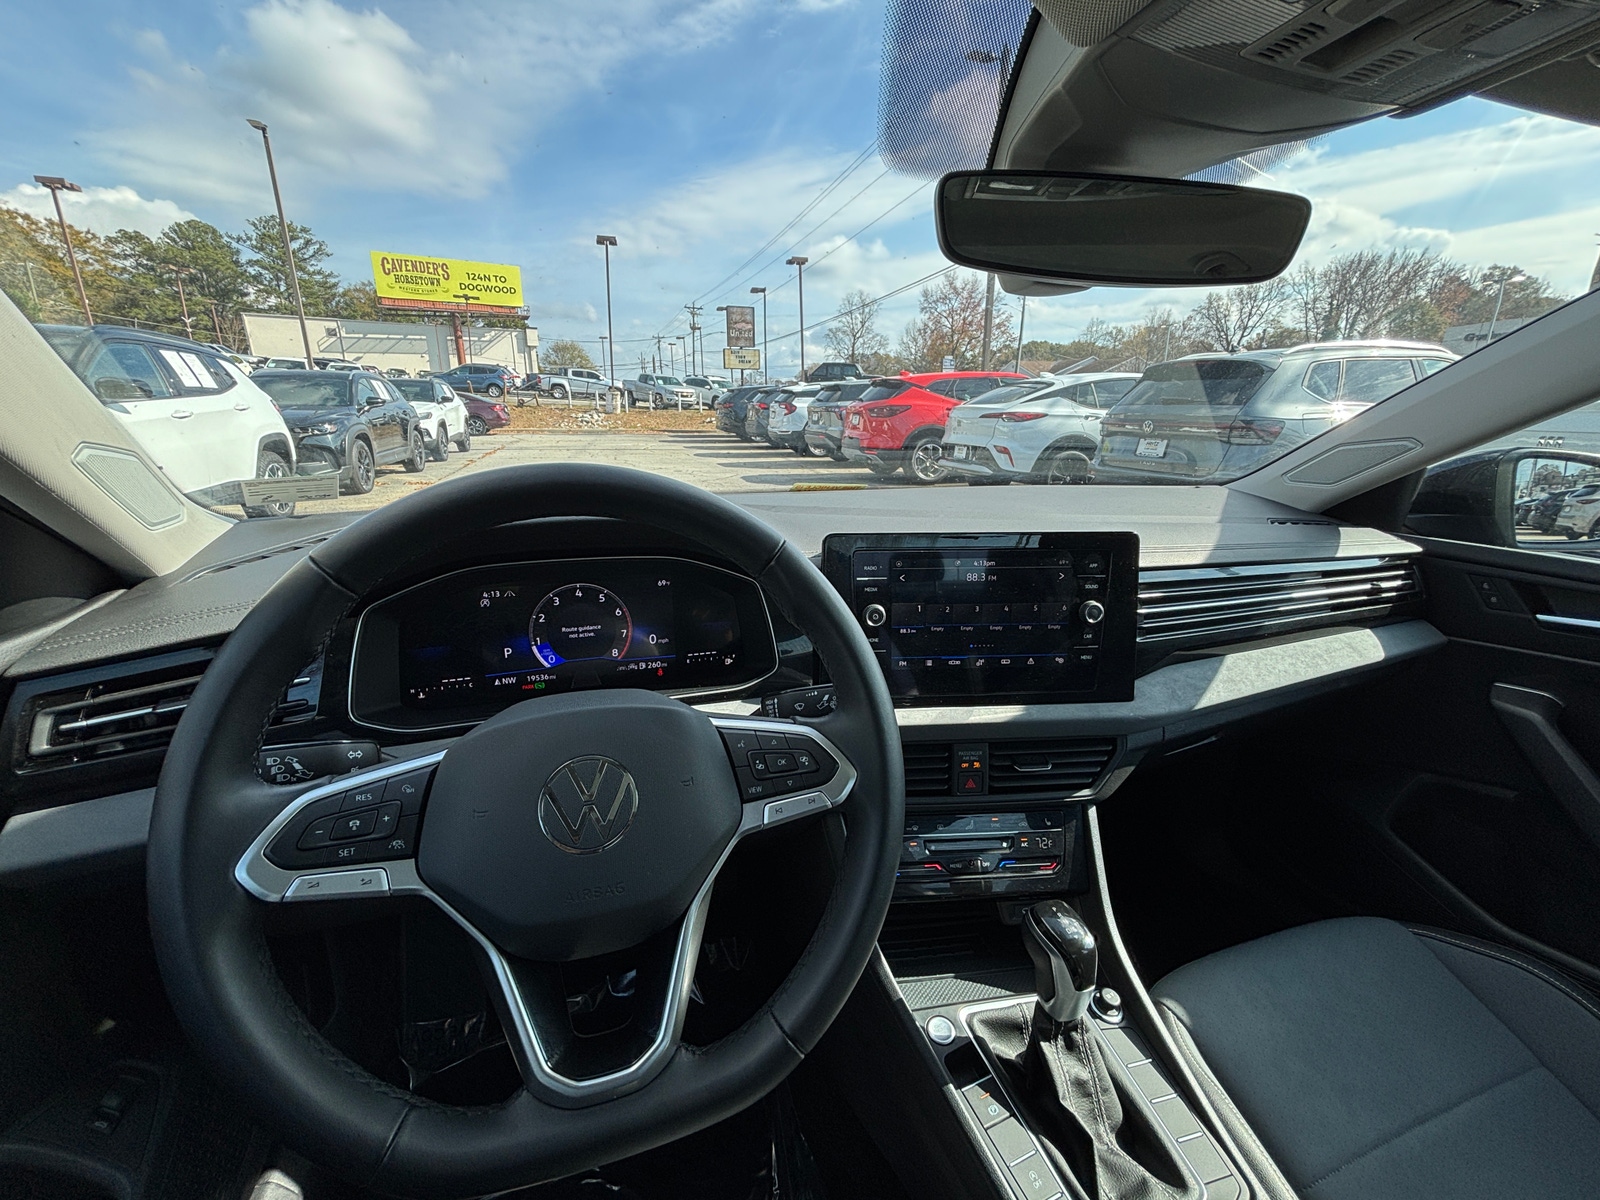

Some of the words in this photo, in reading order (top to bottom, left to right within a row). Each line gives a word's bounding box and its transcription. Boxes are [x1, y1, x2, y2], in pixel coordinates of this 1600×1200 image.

[380, 256, 450, 280] CAVENDER'S
[394, 274, 441, 287] HORSETOWN
[466, 272, 491, 282] 124N
[493, 275, 507, 284] TO
[459, 282, 516, 294] DOGWOOD
[966, 573, 986, 582] 88.3
[575, 590, 582, 598] 4
[553, 597, 560, 606] 3
[615, 608, 622, 616] 6
[538, 614, 545, 622] 2
[578, 624, 601, 633] guidance
[649, 634, 656, 644] 0
[504, 648, 512, 658] P
[612, 649, 619, 657] 8
[548, 654, 555, 663] 0
[647, 660, 661, 669] 260
[338, 848, 356, 857] SET
[564, 880, 626, 903] AIRBAG
